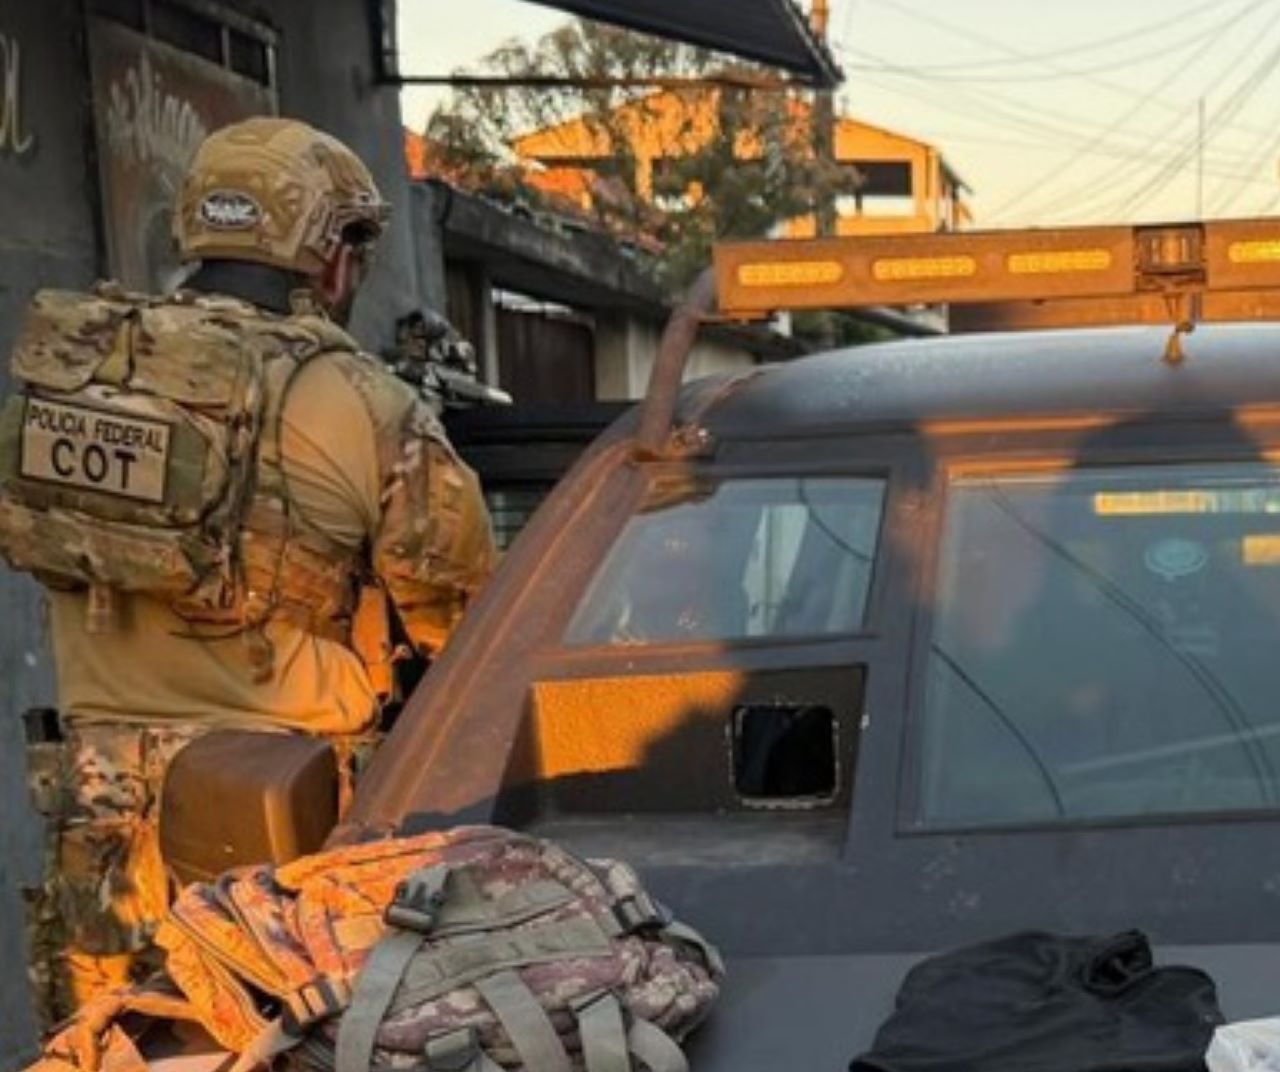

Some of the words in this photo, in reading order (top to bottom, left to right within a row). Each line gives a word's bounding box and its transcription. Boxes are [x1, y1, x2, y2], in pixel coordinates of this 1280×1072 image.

[28, 404, 86, 438] POLICIA
[95, 418, 164, 453] FEDERAL
[52, 438, 138, 490] COT
